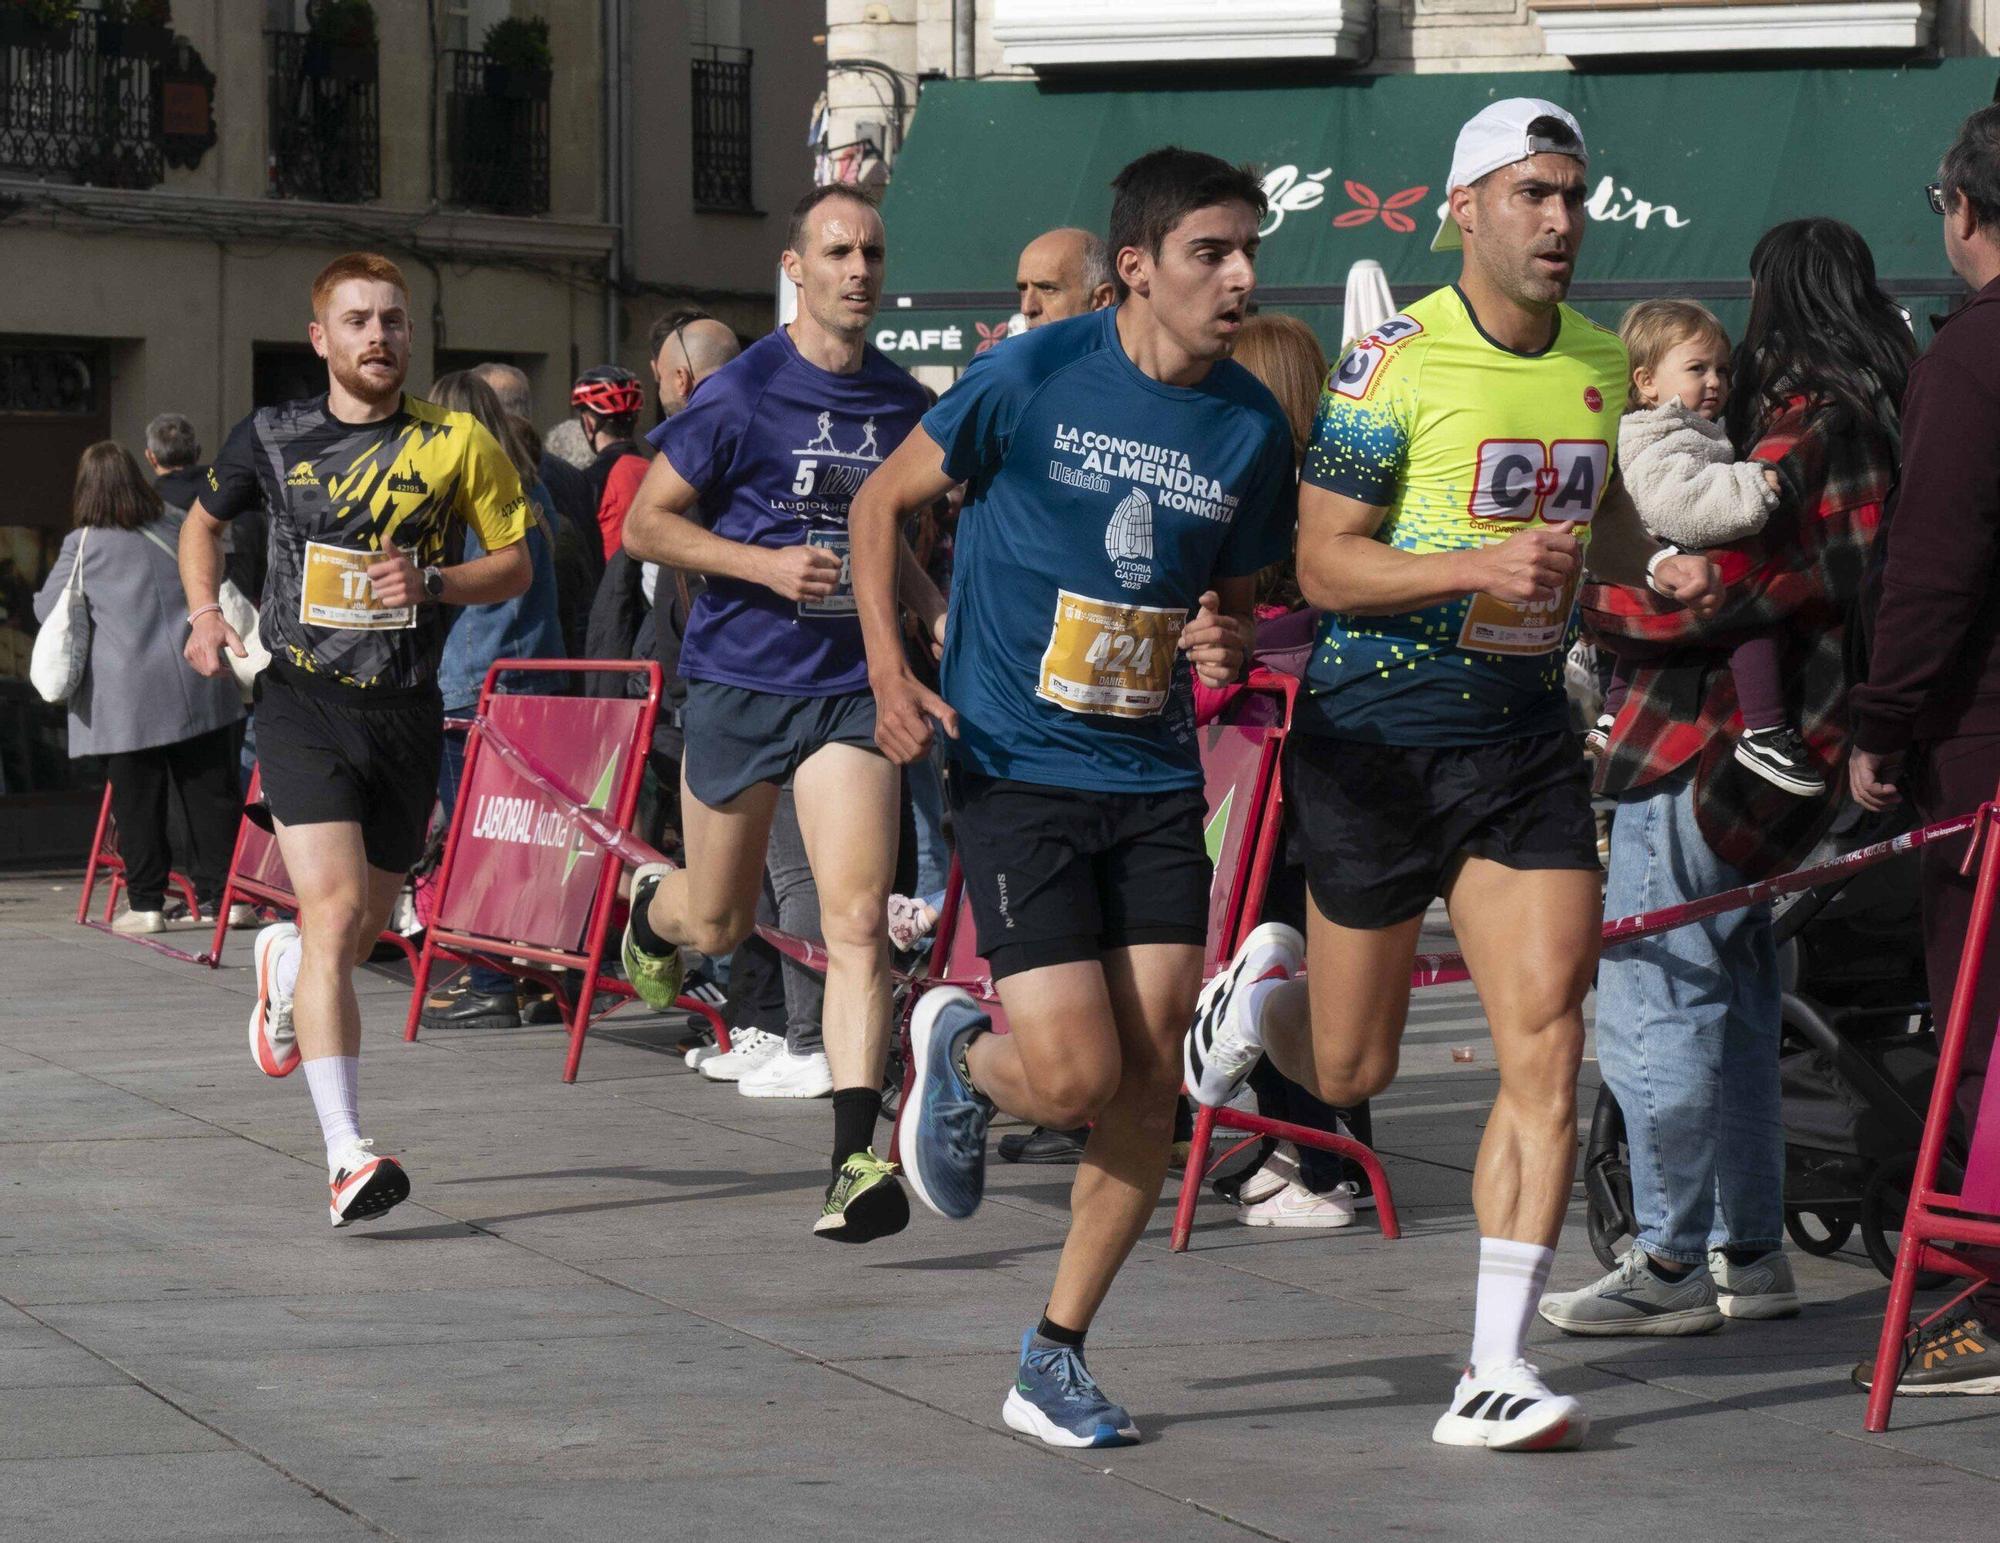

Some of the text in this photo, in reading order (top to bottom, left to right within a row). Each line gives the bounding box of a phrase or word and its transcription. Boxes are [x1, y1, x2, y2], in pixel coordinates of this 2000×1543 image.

[875, 325, 962, 351] CAFÉ
[1056, 423, 1191, 471] LA CONQUISTA
[791, 459, 818, 496] 5
[1053, 439, 1071, 451] DE
[1071, 443, 1087, 456] LA
[1081, 450, 1223, 503] ALMENDRA
[1061, 466, 1111, 494] Edición
[396, 483, 420, 493] 42195
[501, 496, 526, 519] 4219
[1157, 489, 1234, 524] KONKISTA
[1114, 569, 1151, 584] GASTEIZ
[1116, 559, 1152, 574] VITORIA
[1121, 580, 1142, 591] 2025
[1084, 632, 1154, 676] 424
[1099, 676, 1128, 688] DANIEL
[472, 794, 536, 844] LABORAL
